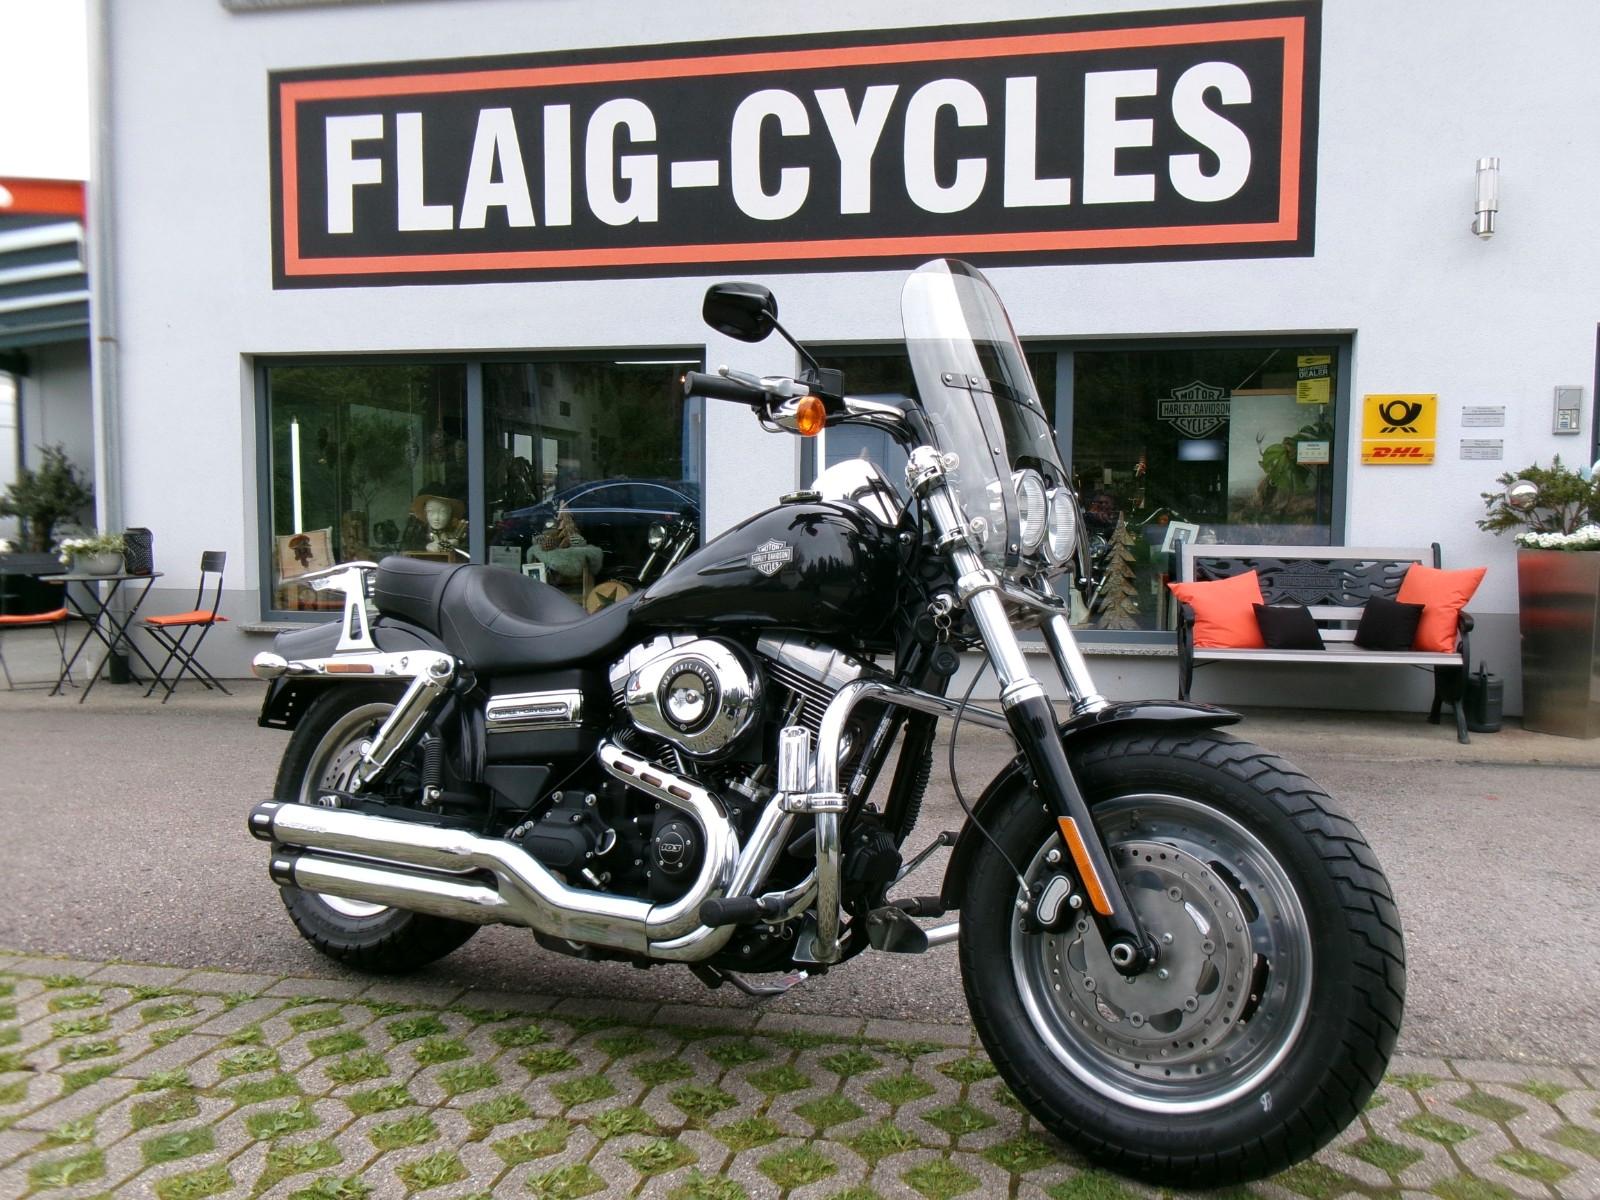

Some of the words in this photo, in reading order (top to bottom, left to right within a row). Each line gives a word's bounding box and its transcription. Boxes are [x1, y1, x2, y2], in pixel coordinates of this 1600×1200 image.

[325, 61, 1252, 236] FLAIG-CYCLES
[1299, 368, 1328, 378] DEALER
[1180, 388, 1215, 400] MOTOR
[1163, 402, 1230, 415] HARLEY-DAVIDSON
[1179, 419, 1215, 433] CYCLES
[1372, 447, 1424, 457] DHL
